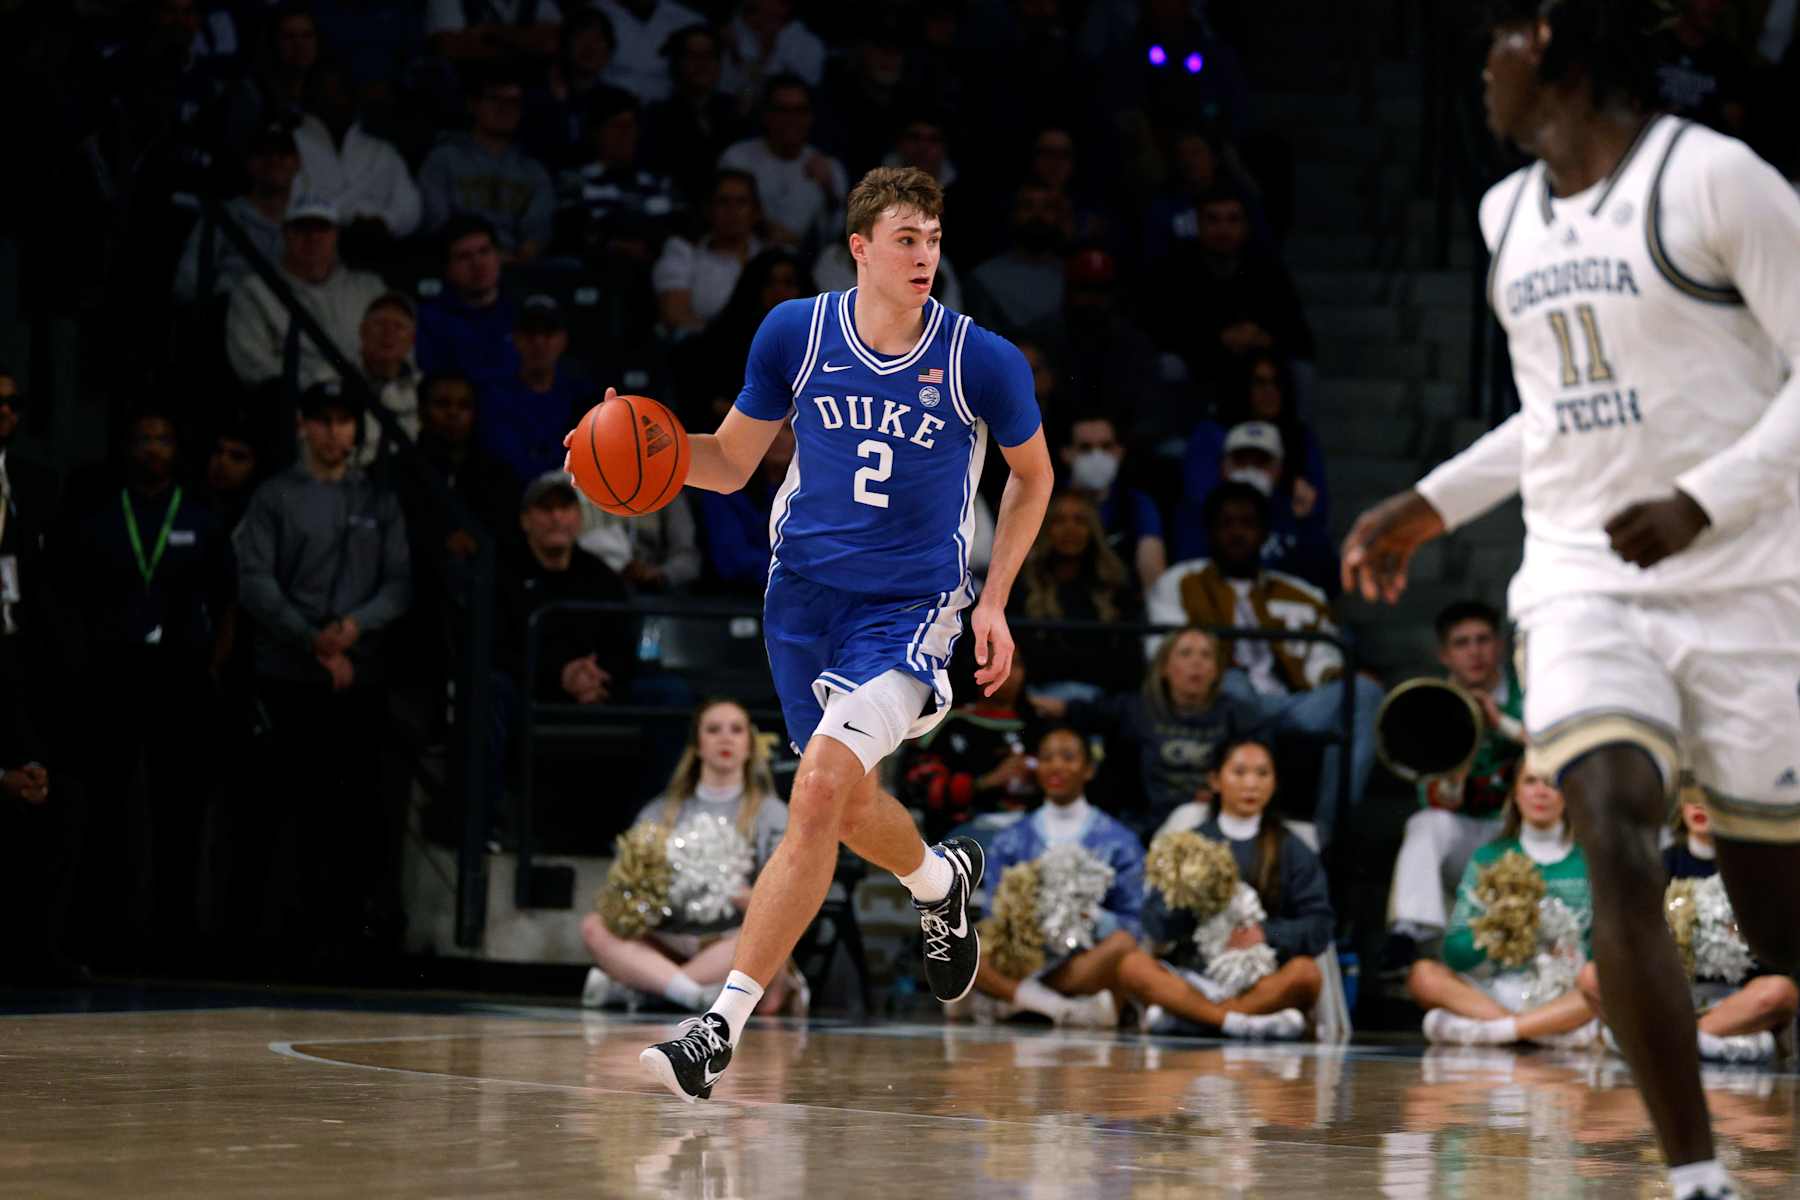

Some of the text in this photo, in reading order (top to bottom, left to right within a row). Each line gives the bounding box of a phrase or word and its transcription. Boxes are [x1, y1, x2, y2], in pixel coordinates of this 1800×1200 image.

[1507, 257, 1640, 316] GEORGIA
[1547, 303, 1615, 387] 11
[813, 395, 946, 450] DUKE
[1554, 388, 1642, 434] TECH
[853, 439, 894, 509] 2
